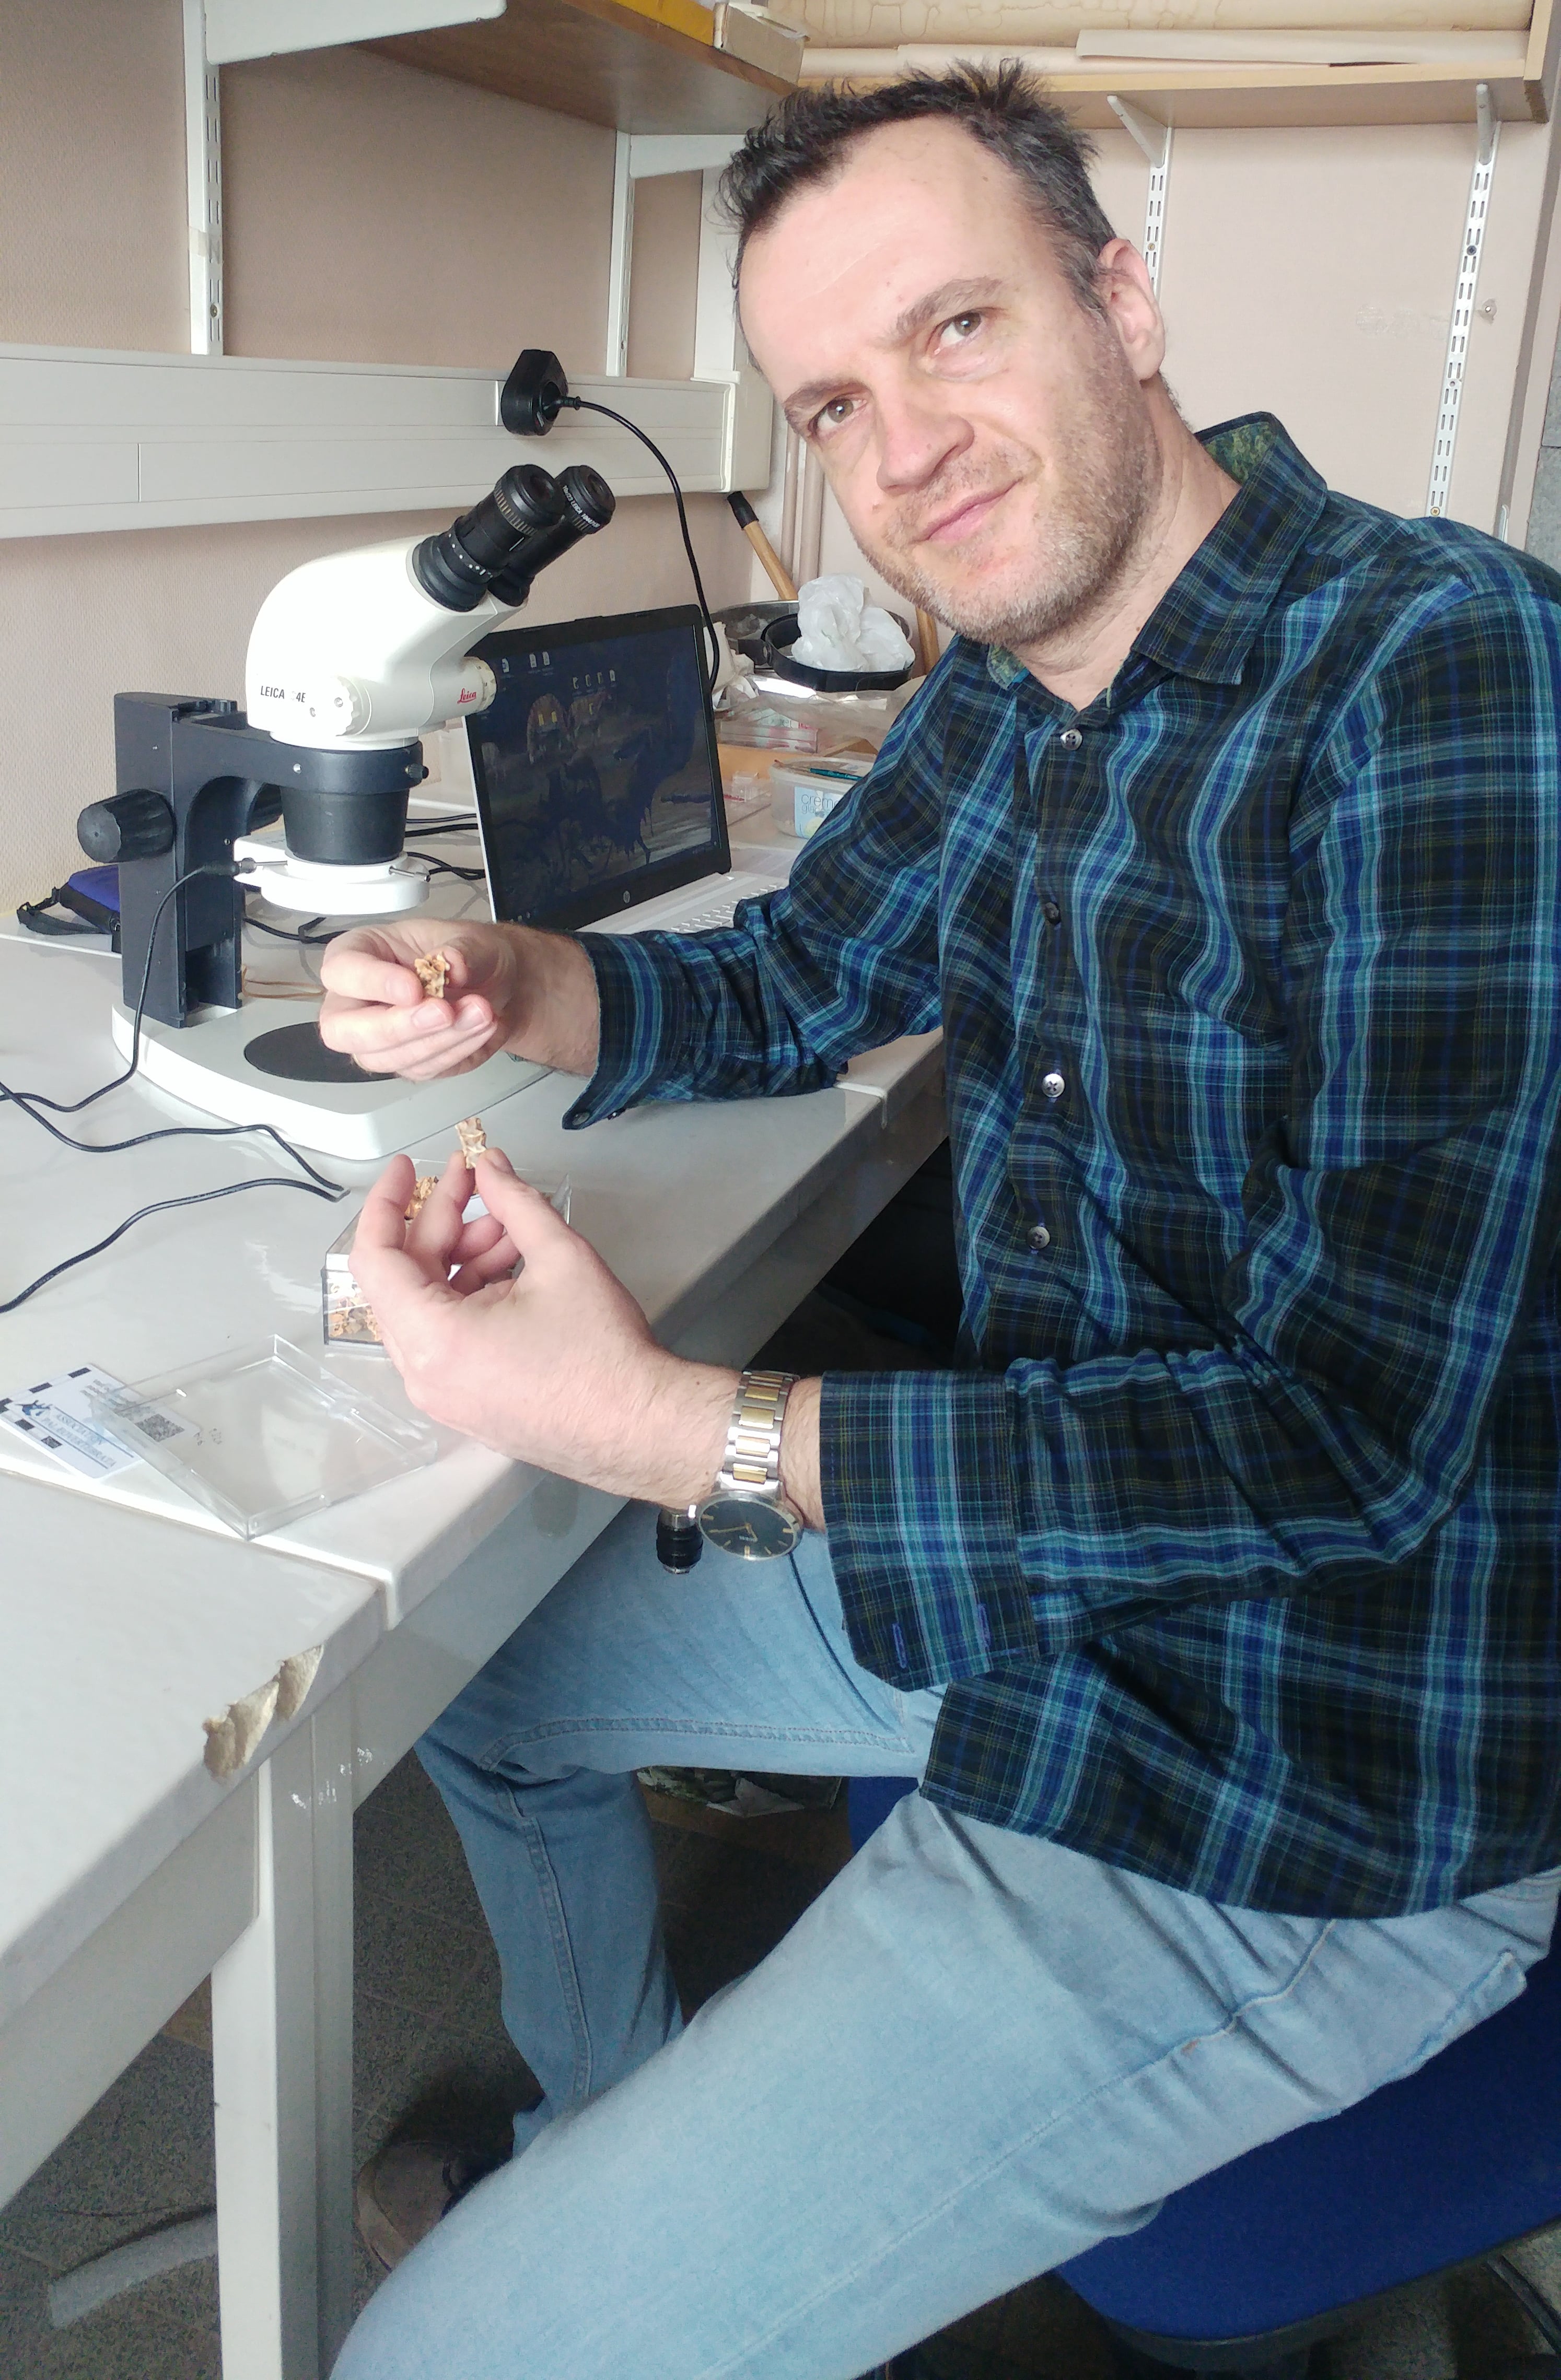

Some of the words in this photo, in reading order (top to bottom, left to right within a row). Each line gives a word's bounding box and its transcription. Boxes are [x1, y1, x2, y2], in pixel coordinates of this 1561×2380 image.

[570, 500, 583, 514] LEICA
[261, 685, 285, 699] LEICA
[292, 691, 306, 702] 4E
[457, 688, 476, 704] Leica
